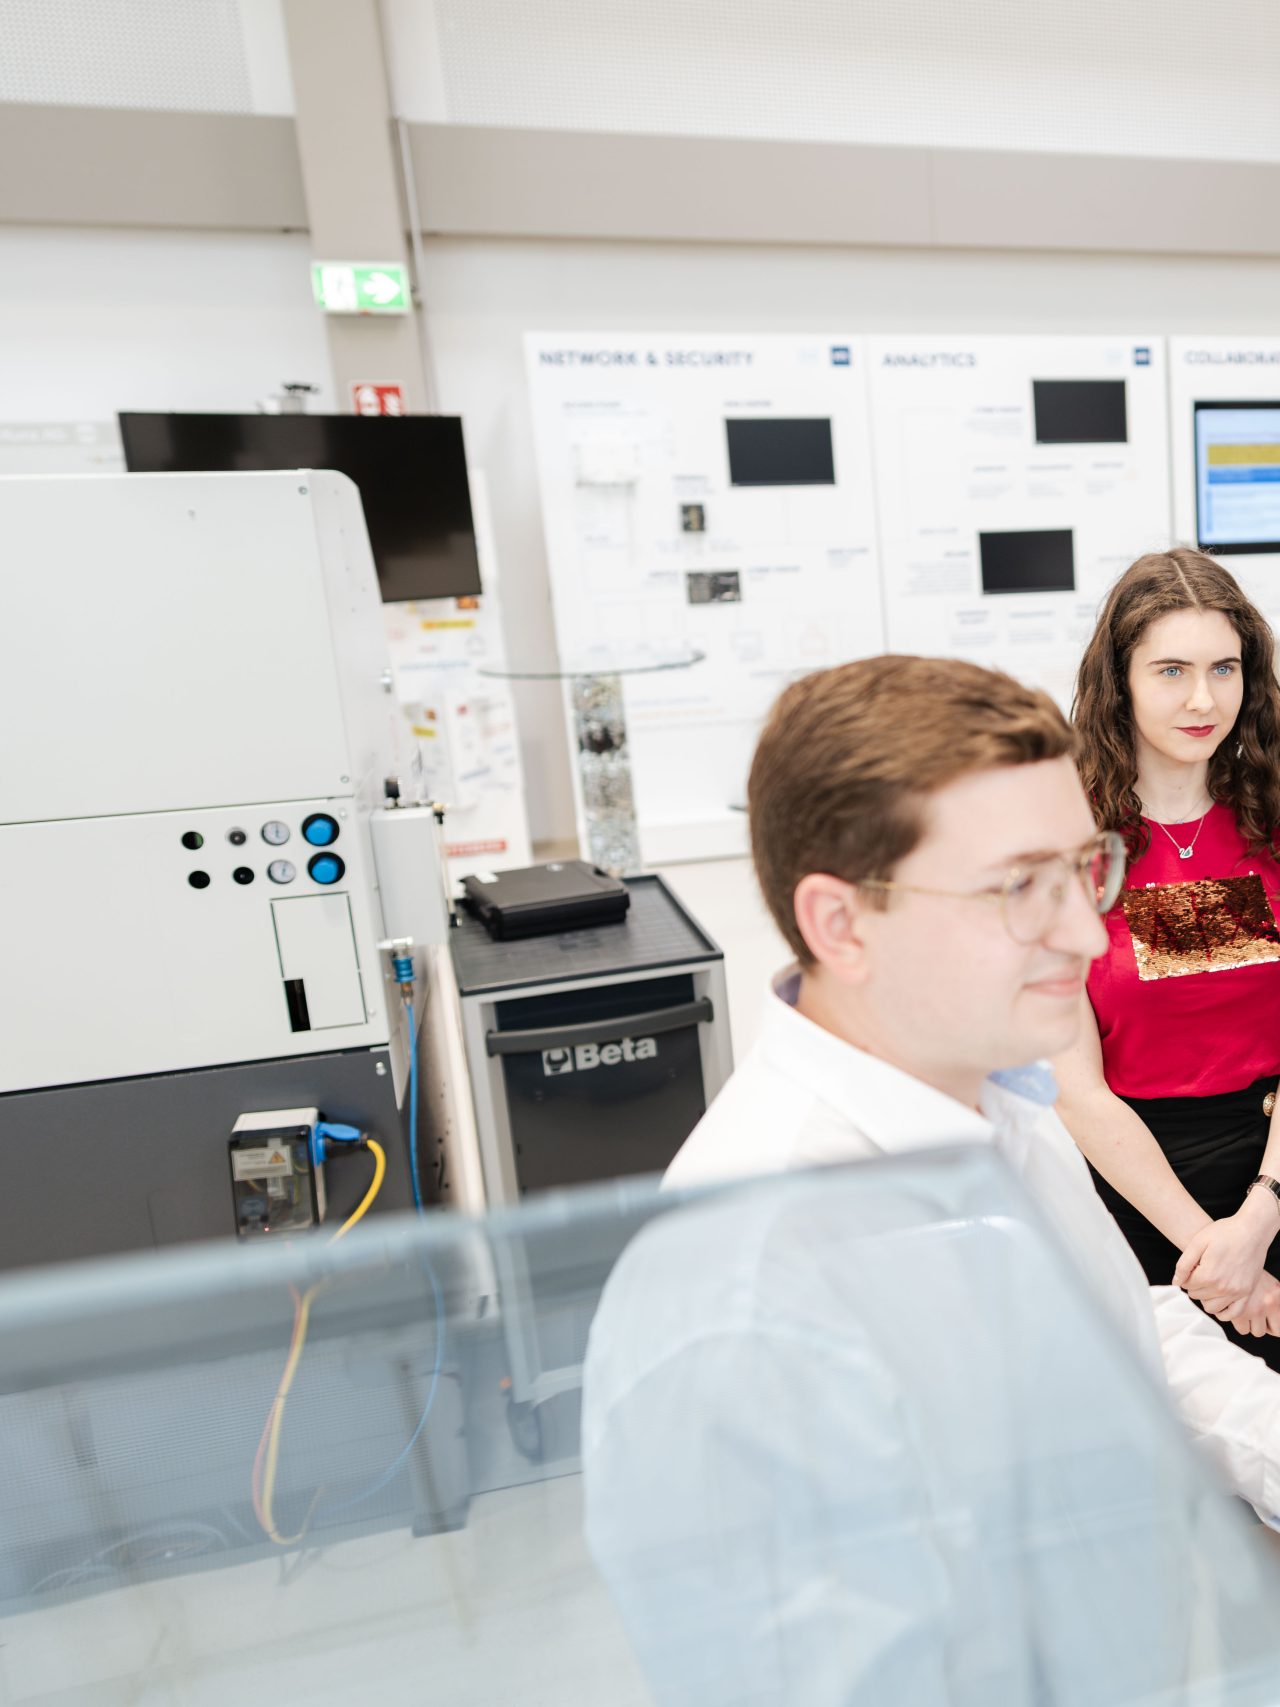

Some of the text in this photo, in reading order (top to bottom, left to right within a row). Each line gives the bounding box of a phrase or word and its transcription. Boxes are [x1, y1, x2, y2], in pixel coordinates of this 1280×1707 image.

[539, 350, 754, 367] NETWORK & SECURITY
[882, 352, 976, 367] ANALYTICS
[575, 1037, 657, 1071] Beta
